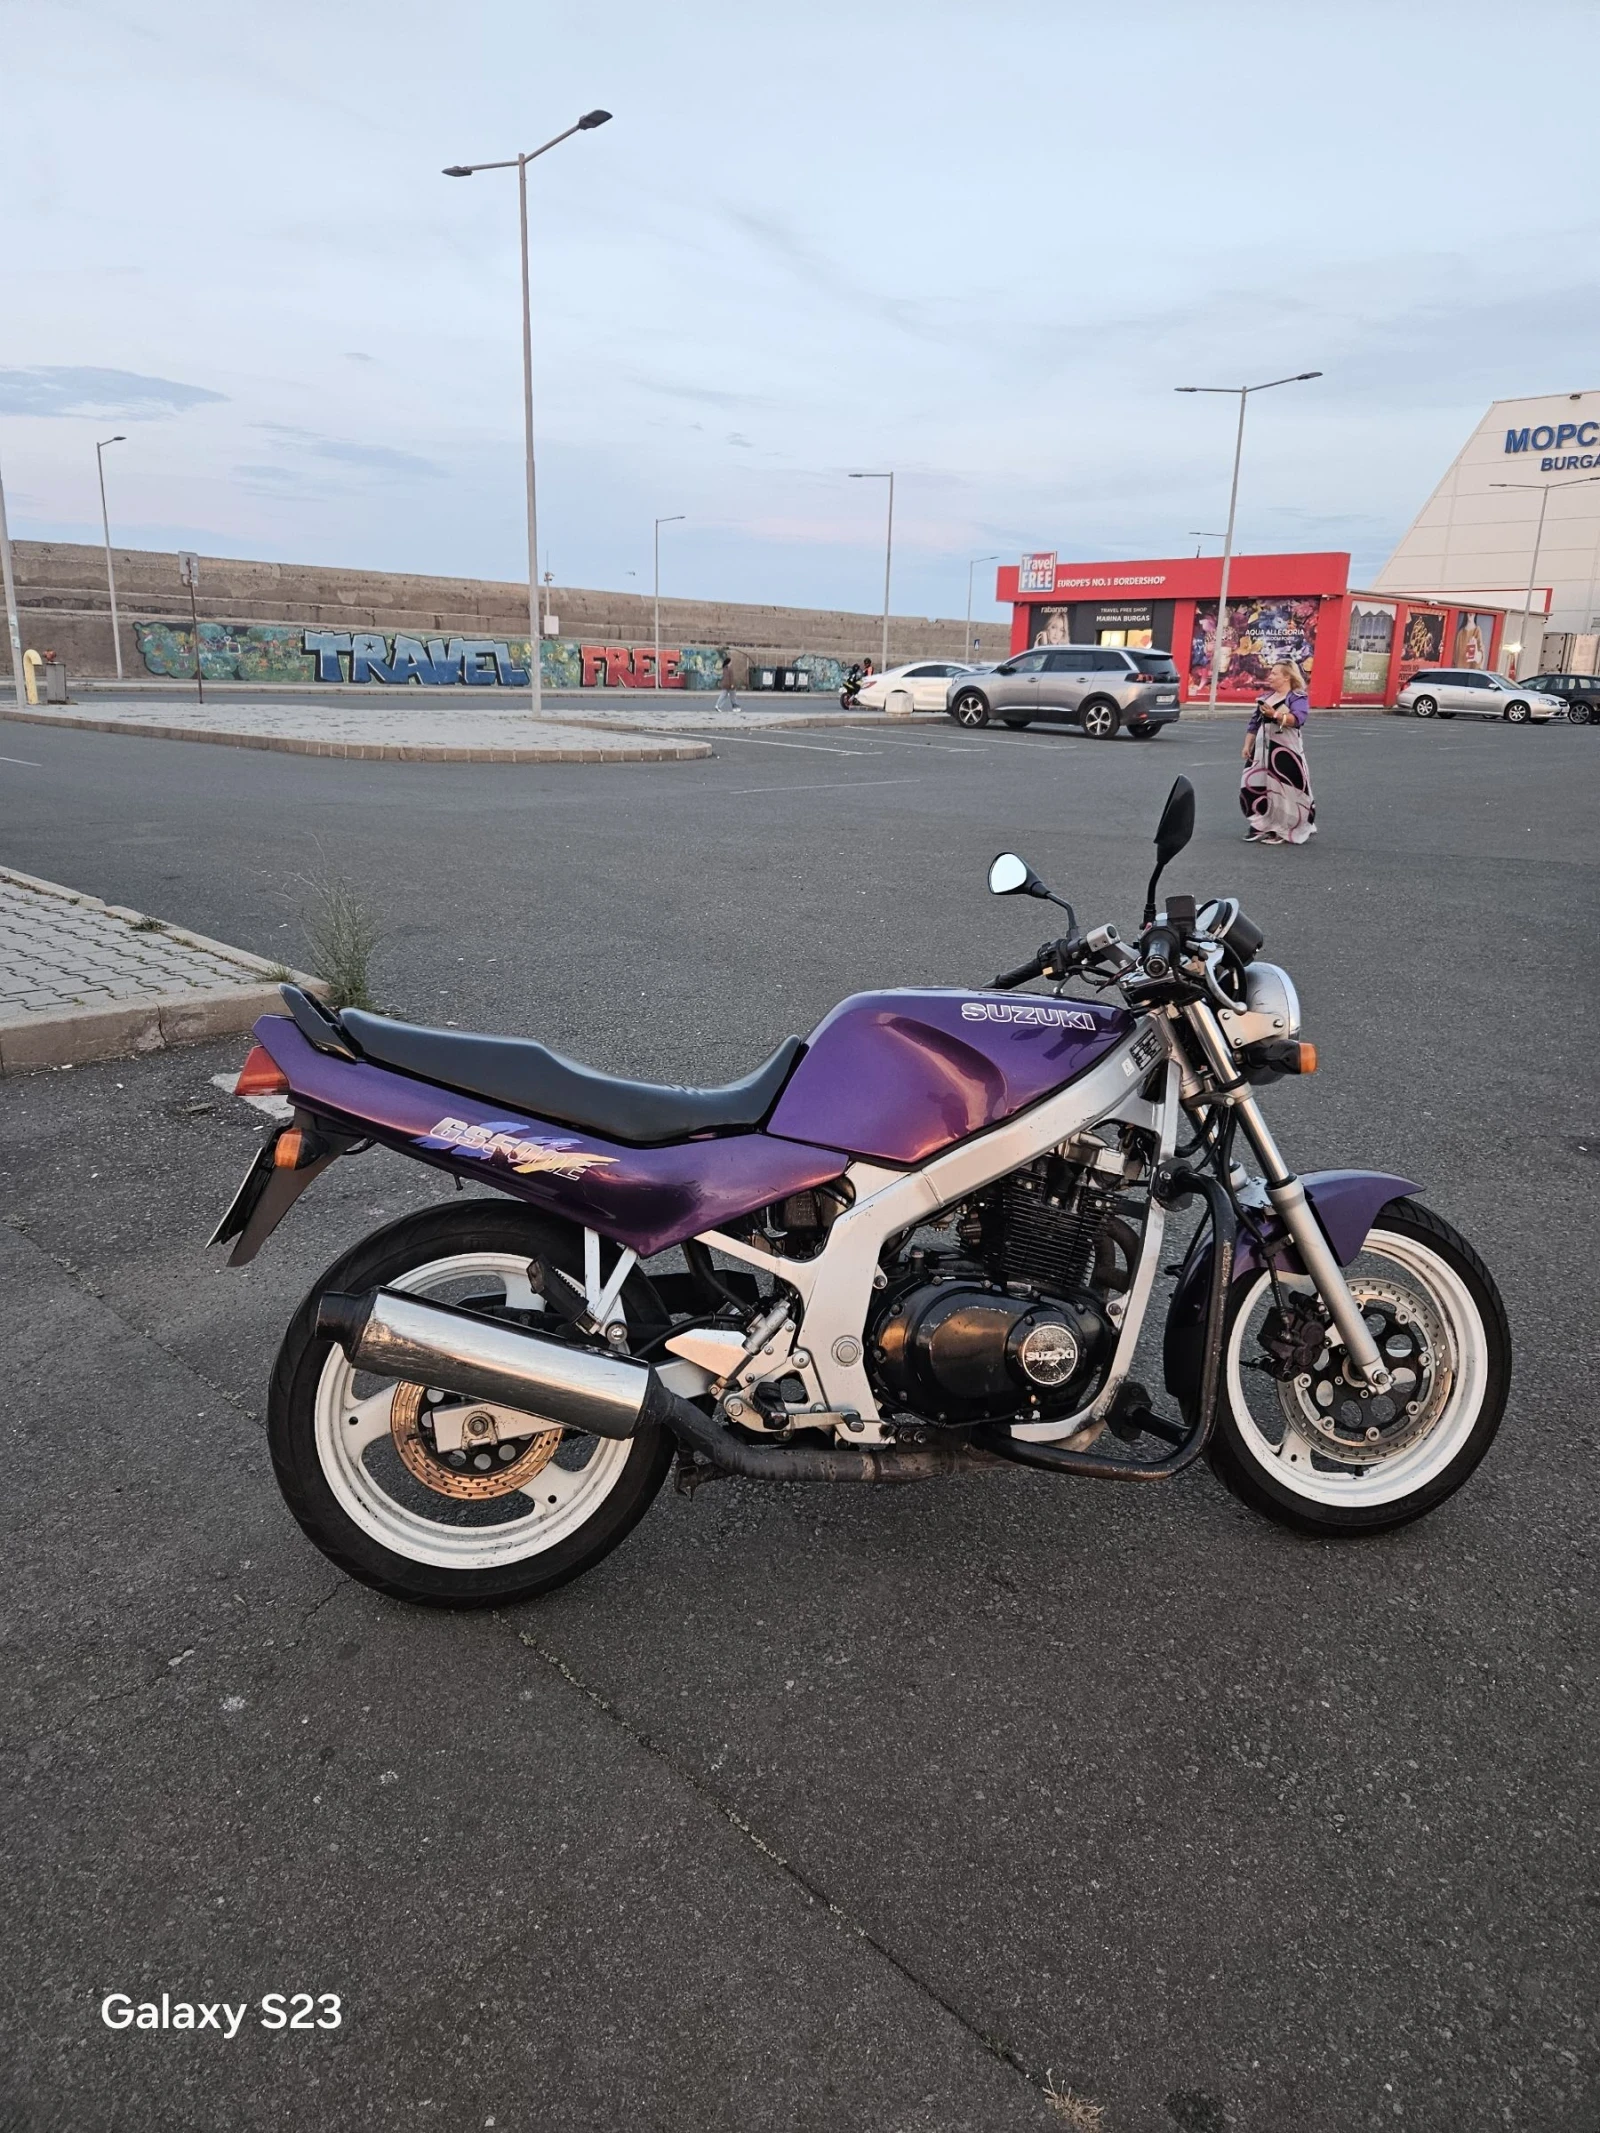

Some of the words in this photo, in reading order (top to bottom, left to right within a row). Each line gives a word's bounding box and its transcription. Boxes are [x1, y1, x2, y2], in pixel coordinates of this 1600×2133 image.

[1022, 555, 1053, 570] Travel
[1021, 571, 1052, 588] FREE
[1057, 578, 1090, 588] EUROPE'S
[1113, 576, 1166, 586] BORDERSHOP
[1041, 606, 1068, 614] rabanne
[301, 631, 530, 686] TRAVEL
[579, 644, 685, 687] FREE
[961, 1003, 1096, 1031] SUZUKI
[430, 1117, 588, 1181] GS500E
[1025, 1349, 1074, 1362] SUZKI
